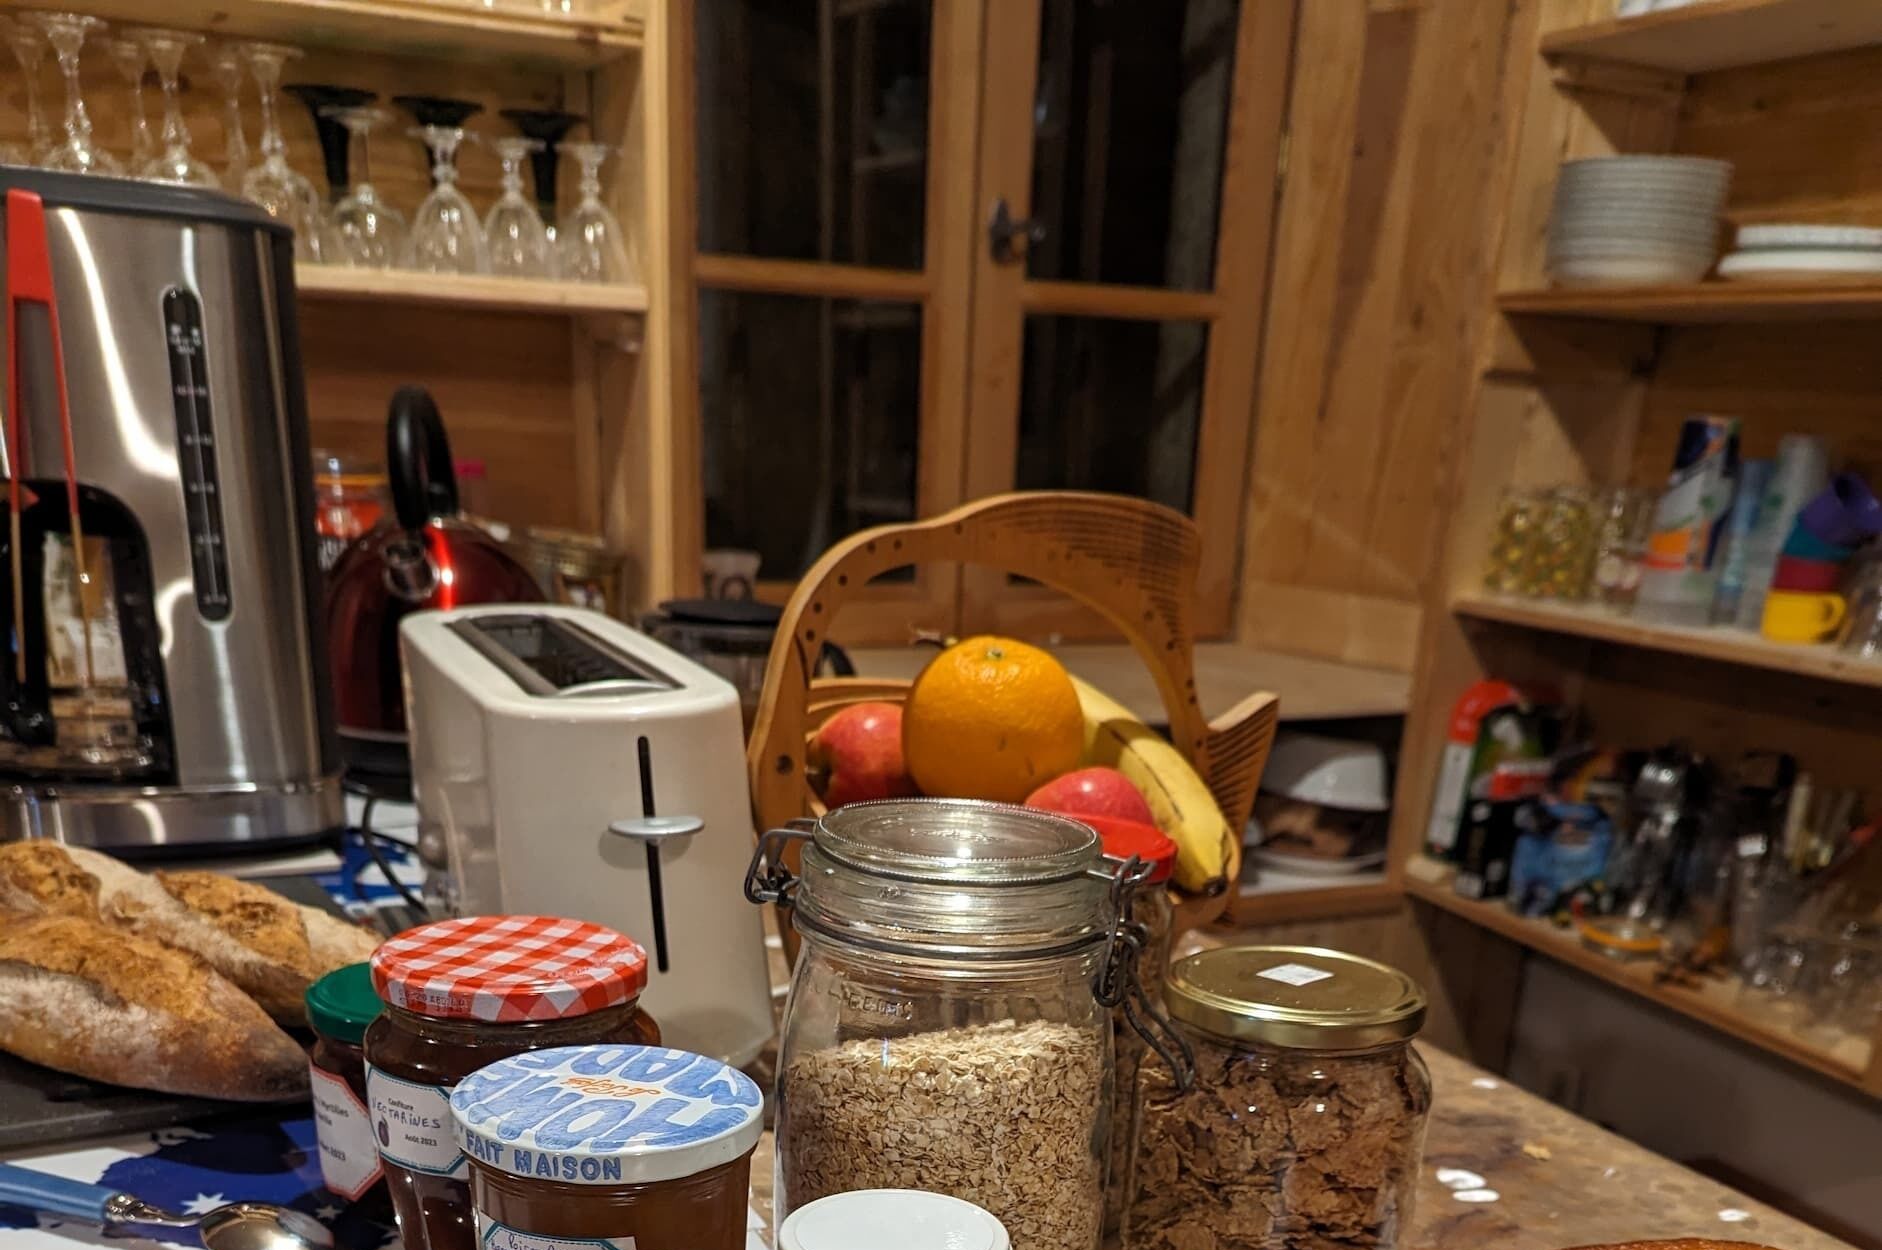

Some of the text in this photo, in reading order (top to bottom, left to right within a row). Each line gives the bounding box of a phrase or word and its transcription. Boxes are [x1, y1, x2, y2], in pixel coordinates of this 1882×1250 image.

[450, 1061, 749, 1154] HOME
[420, 1136, 439, 1148] 2023
[465, 1129, 622, 1181] FAIT MAISON
